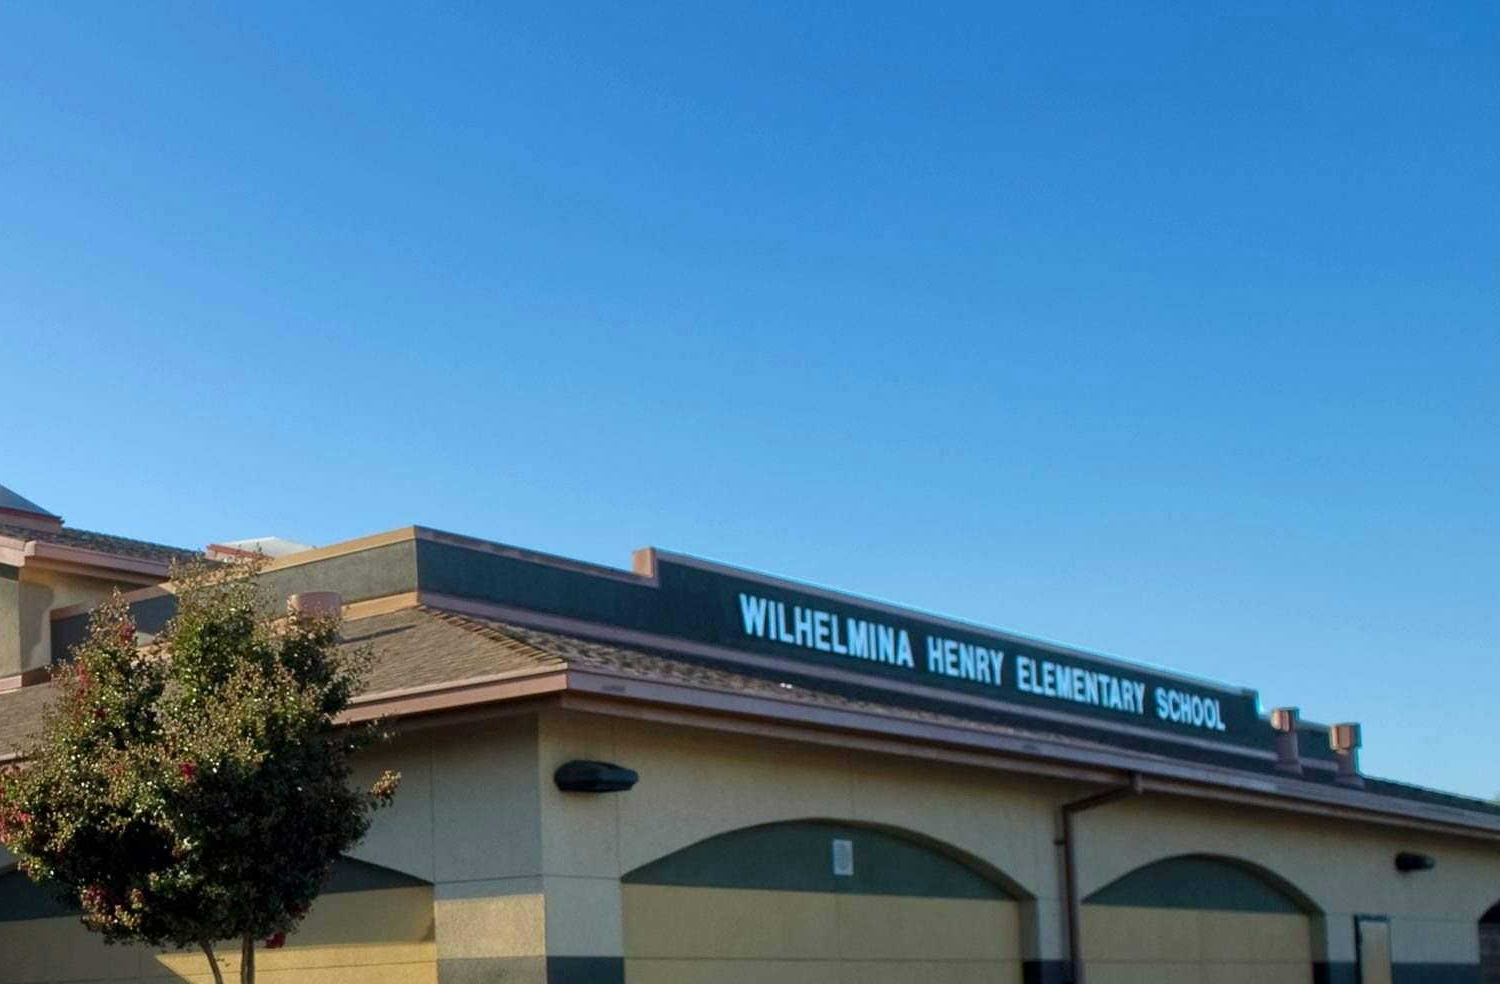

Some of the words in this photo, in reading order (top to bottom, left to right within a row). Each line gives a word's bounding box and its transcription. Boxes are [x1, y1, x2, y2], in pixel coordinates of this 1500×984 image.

[739, 593, 914, 668] WILHELMINA
[927, 635, 1004, 686] HENRY
[1016, 655, 1145, 714] ELEMENTARY
[1155, 687, 1226, 730] SCHOOL
